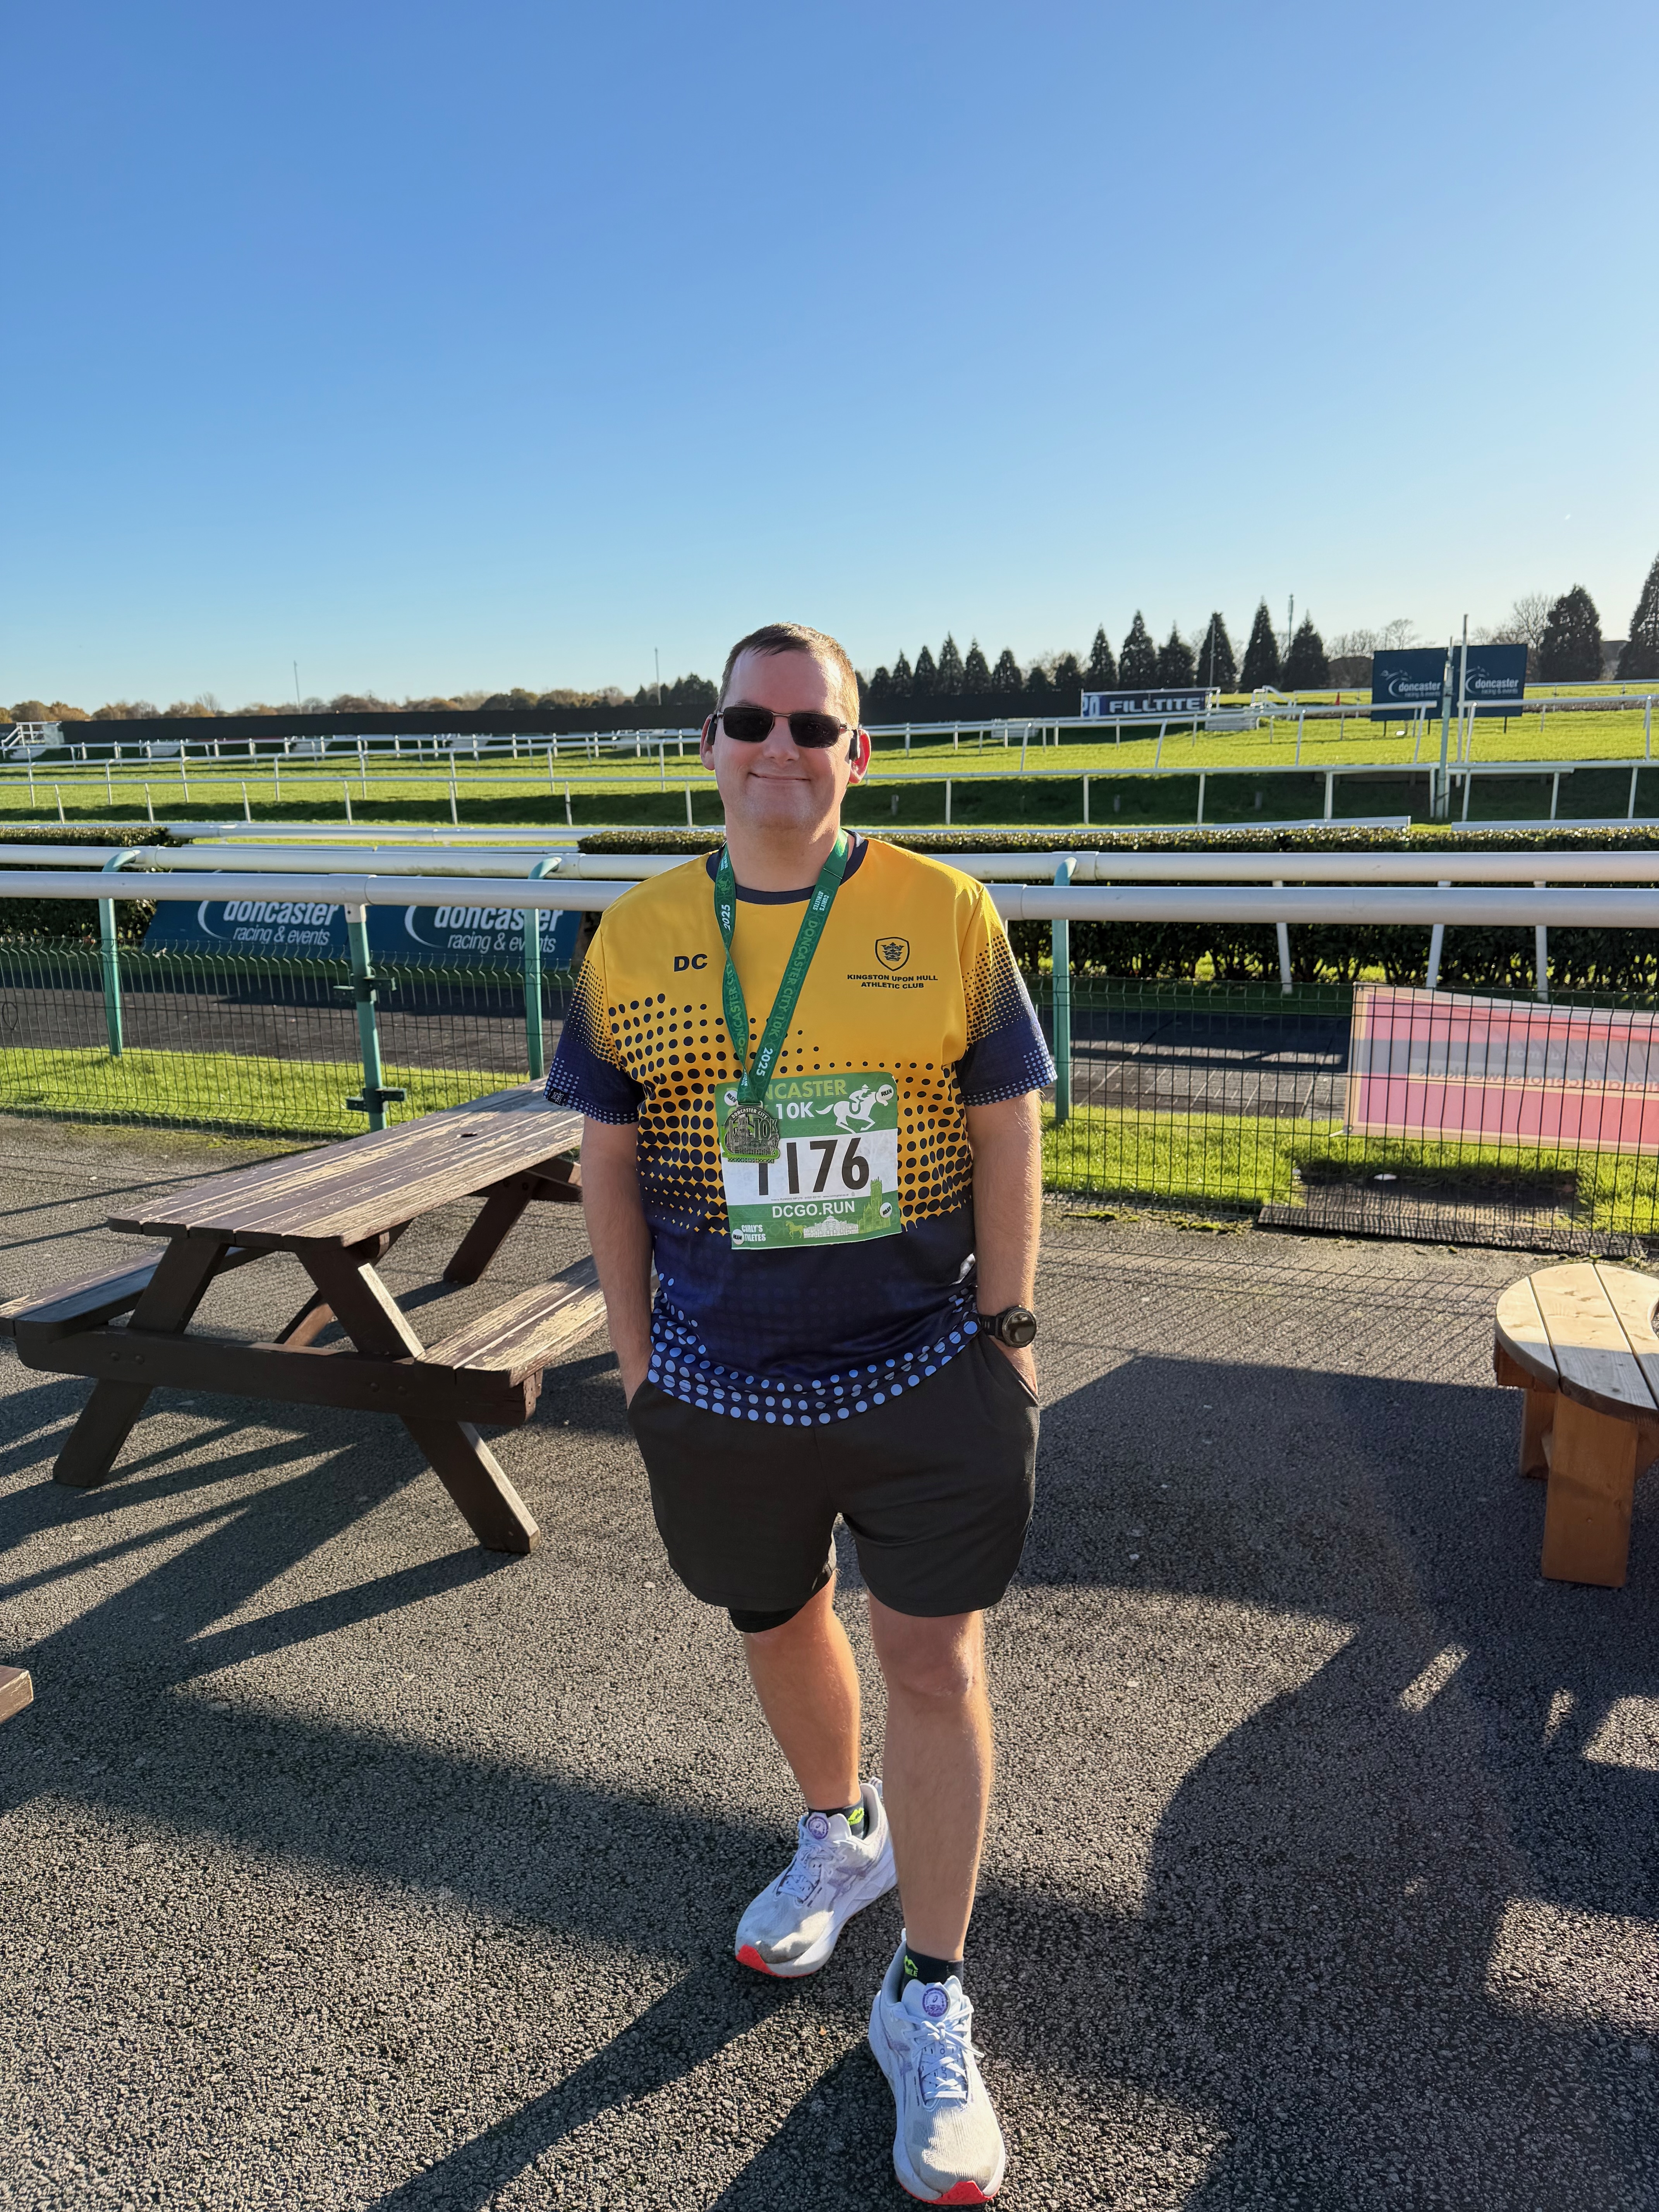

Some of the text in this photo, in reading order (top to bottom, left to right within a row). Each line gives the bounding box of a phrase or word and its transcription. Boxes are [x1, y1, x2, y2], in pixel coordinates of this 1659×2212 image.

[1398, 681, 1441, 692] doncaster
[1475, 678, 1519, 689] doncaster
[1109, 697, 1200, 713] FILLTITE
[223, 901, 339, 926] doncaster
[434, 906, 563, 932] doncaser
[721, 904, 731, 931] 2025
[233, 924, 330, 945] racing & events
[447, 931, 556, 954] racing & evts
[674, 954, 708, 972] DC
[768, 920, 818, 1038] DONCASTER CITY 10K
[729, 987, 745, 1055] DONCASTER
[756, 1047, 773, 1076] 2025
[726, 1079, 847, 1104] NCASTER
[731, 1108, 757, 1119] DONCASTER
[758, 1111, 768, 1119] CITY
[776, 1101, 814, 1120] 10K
[753, 1119, 778, 1141] 10K
[759, 1137, 869, 1196] 1176
[772, 1201, 855, 1218] DCGO.RUN
[744, 1233, 766, 1242] THLETES
